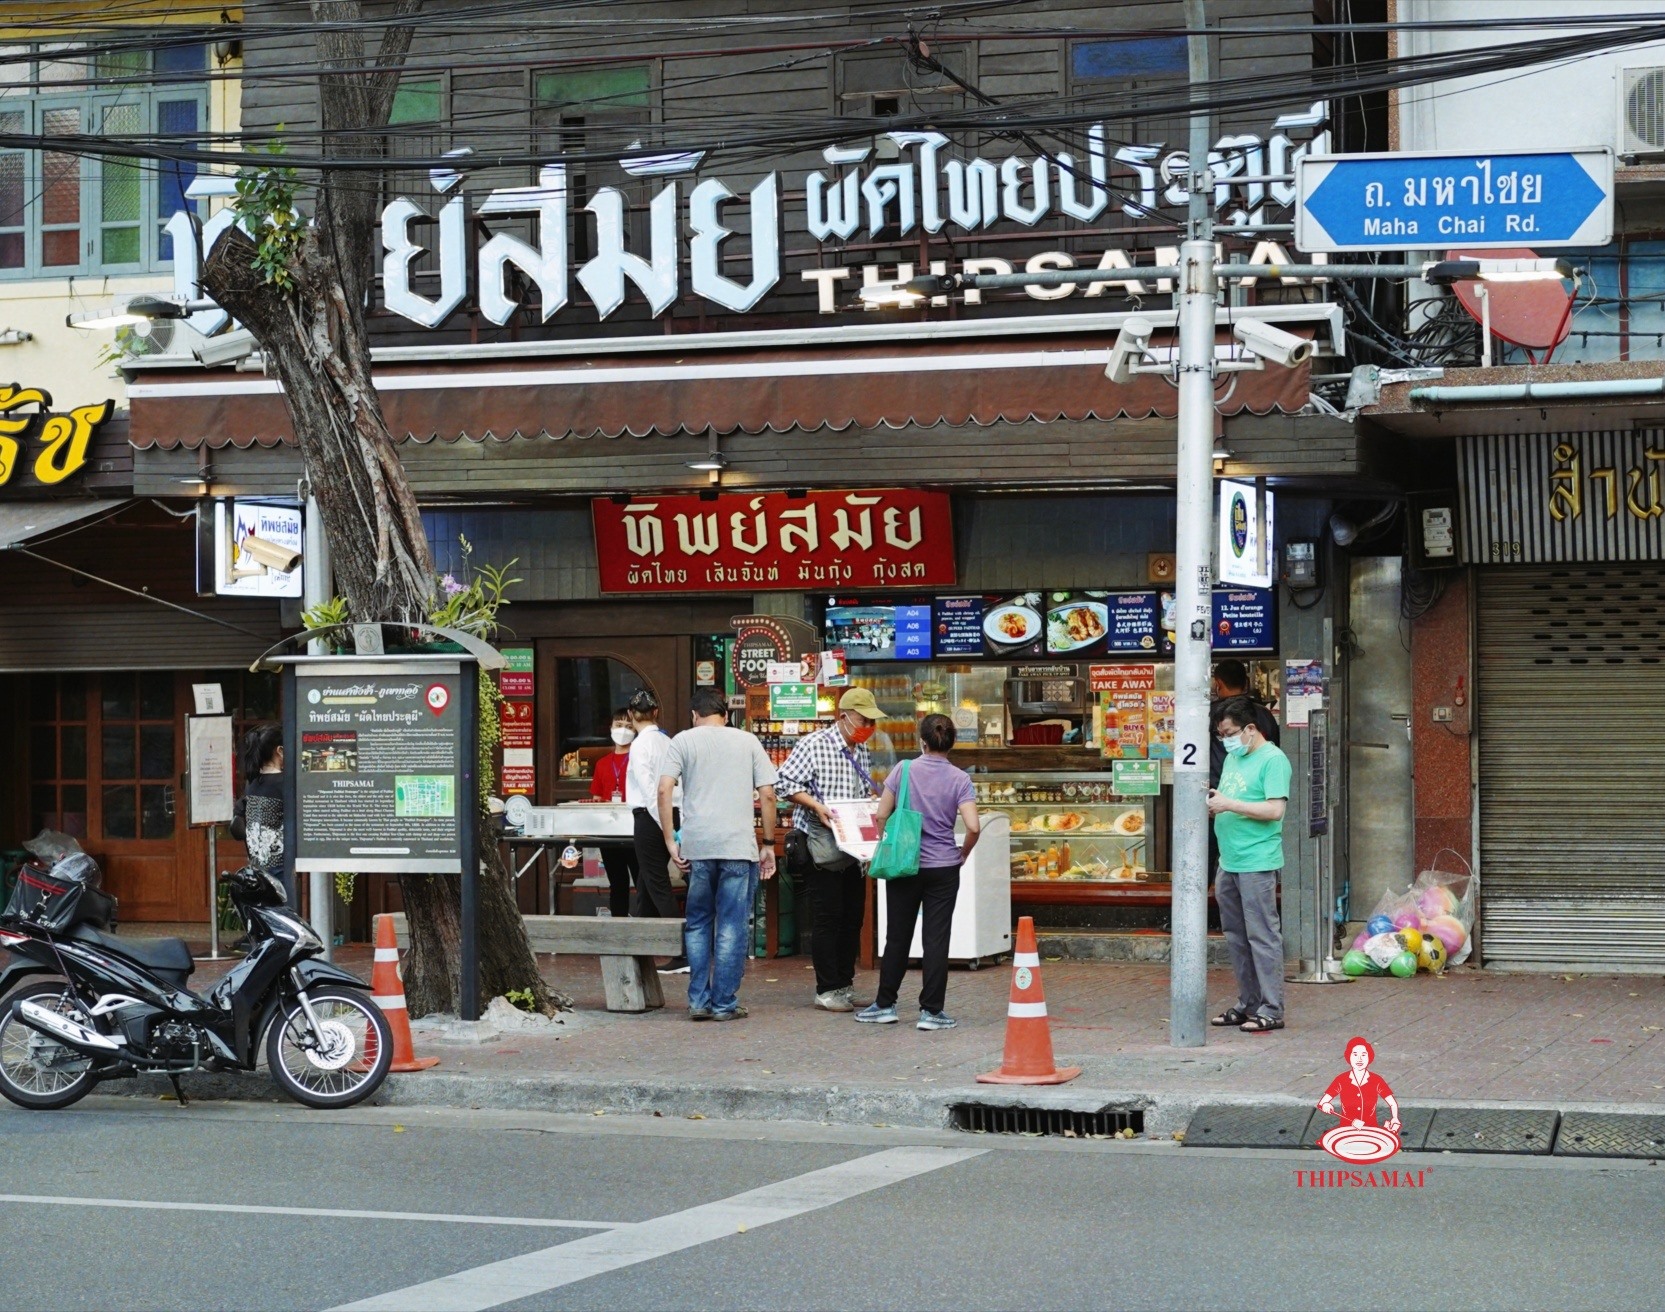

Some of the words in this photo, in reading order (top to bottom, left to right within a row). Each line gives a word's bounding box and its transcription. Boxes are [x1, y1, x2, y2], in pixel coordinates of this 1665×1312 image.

[1364, 180, 1391, 207] ถ.
[1403, 159, 1542, 207] มหาไชย
[1364, 217, 1419, 236] Maha
[1438, 215, 1486, 234] Chai
[1506, 214, 1540, 233] Rd.
[622, 493, 924, 558] ทิพย์สมัย
[1492, 542, 1520, 557] 319
[627, 560, 688, 585] ผัดไทย
[798, 559, 853, 586] มันกุ้ง
[873, 559, 926, 586] กุ้งสด
[741, 648, 775, 658] STREET
[906, 648, 919, 656] A03
[1092, 680, 1117, 689] TAKE
[1122, 680, 1153, 689] AWAY
[1152, 695, 1169, 704] BUY
[1152, 704, 1169, 712] GET
[309, 709, 351, 723] ทิพย์สมัย
[1182, 743, 1197, 765] 2
[332, 780, 374, 788] THIPSAMAI
